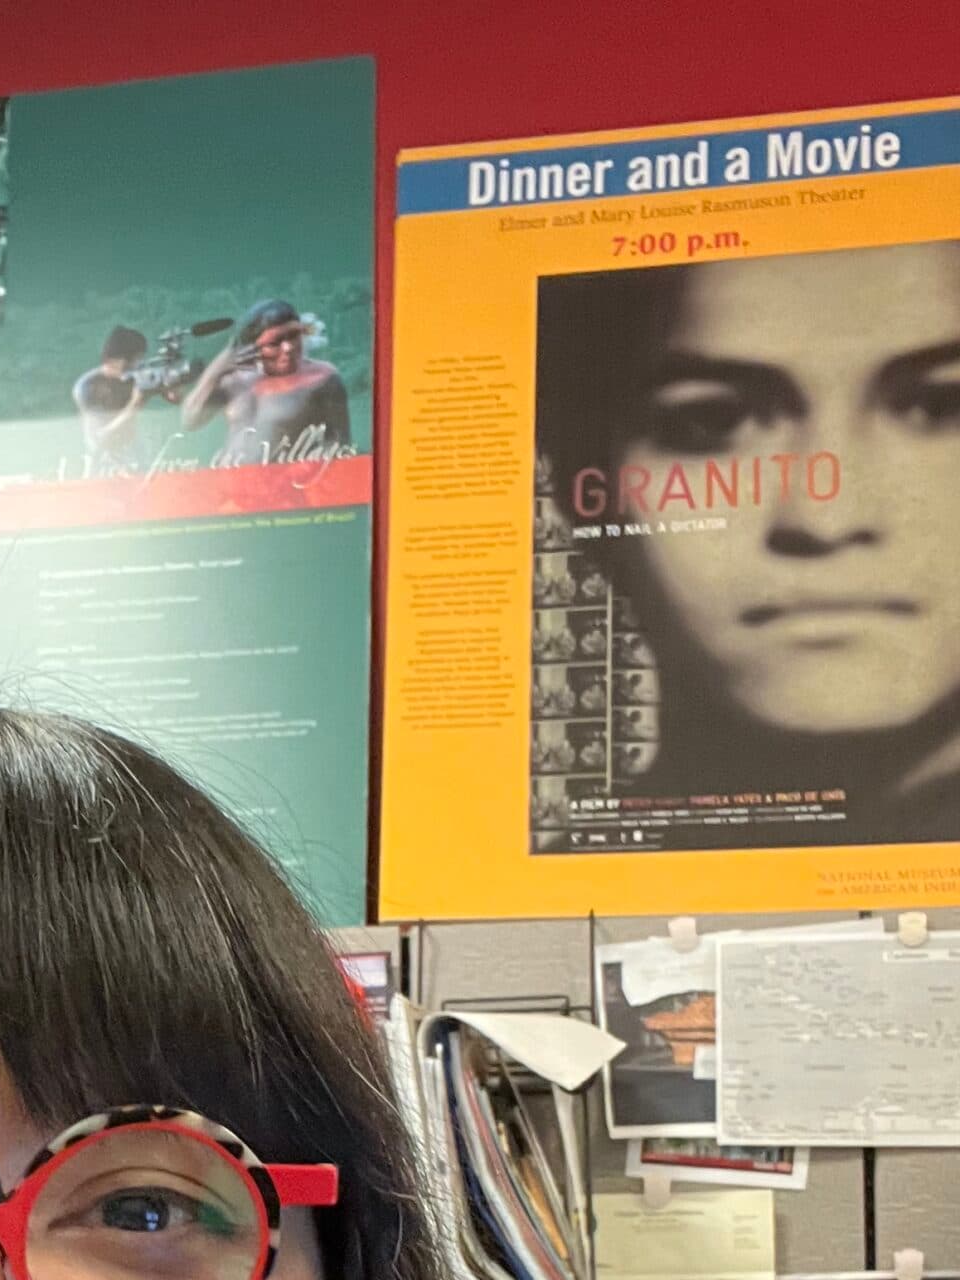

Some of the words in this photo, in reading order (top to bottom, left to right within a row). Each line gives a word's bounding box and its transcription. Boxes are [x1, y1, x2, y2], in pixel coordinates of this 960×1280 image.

[468, 158, 613, 206] Dinner
[626, 140, 709, 193] and
[724, 146, 751, 184] a
[766, 125, 902, 179] Movie
[499, 217, 547, 232] Elmer
[551, 211, 585, 227] and
[590, 208, 634, 225] Mary
[800, 188, 866, 206] Theater
[612, 231, 677, 257] 7:00
[687, 231, 750, 257] p.m.
[260, 422, 358, 490] Villages
[572, 450, 842, 519] GRANITO
[572, 524, 603, 539] HOW
[606, 523, 622, 537] TO
[624, 521, 653, 536] NAIL
[657, 521, 667, 534] A
[670, 518, 727, 532] DICTATOR
